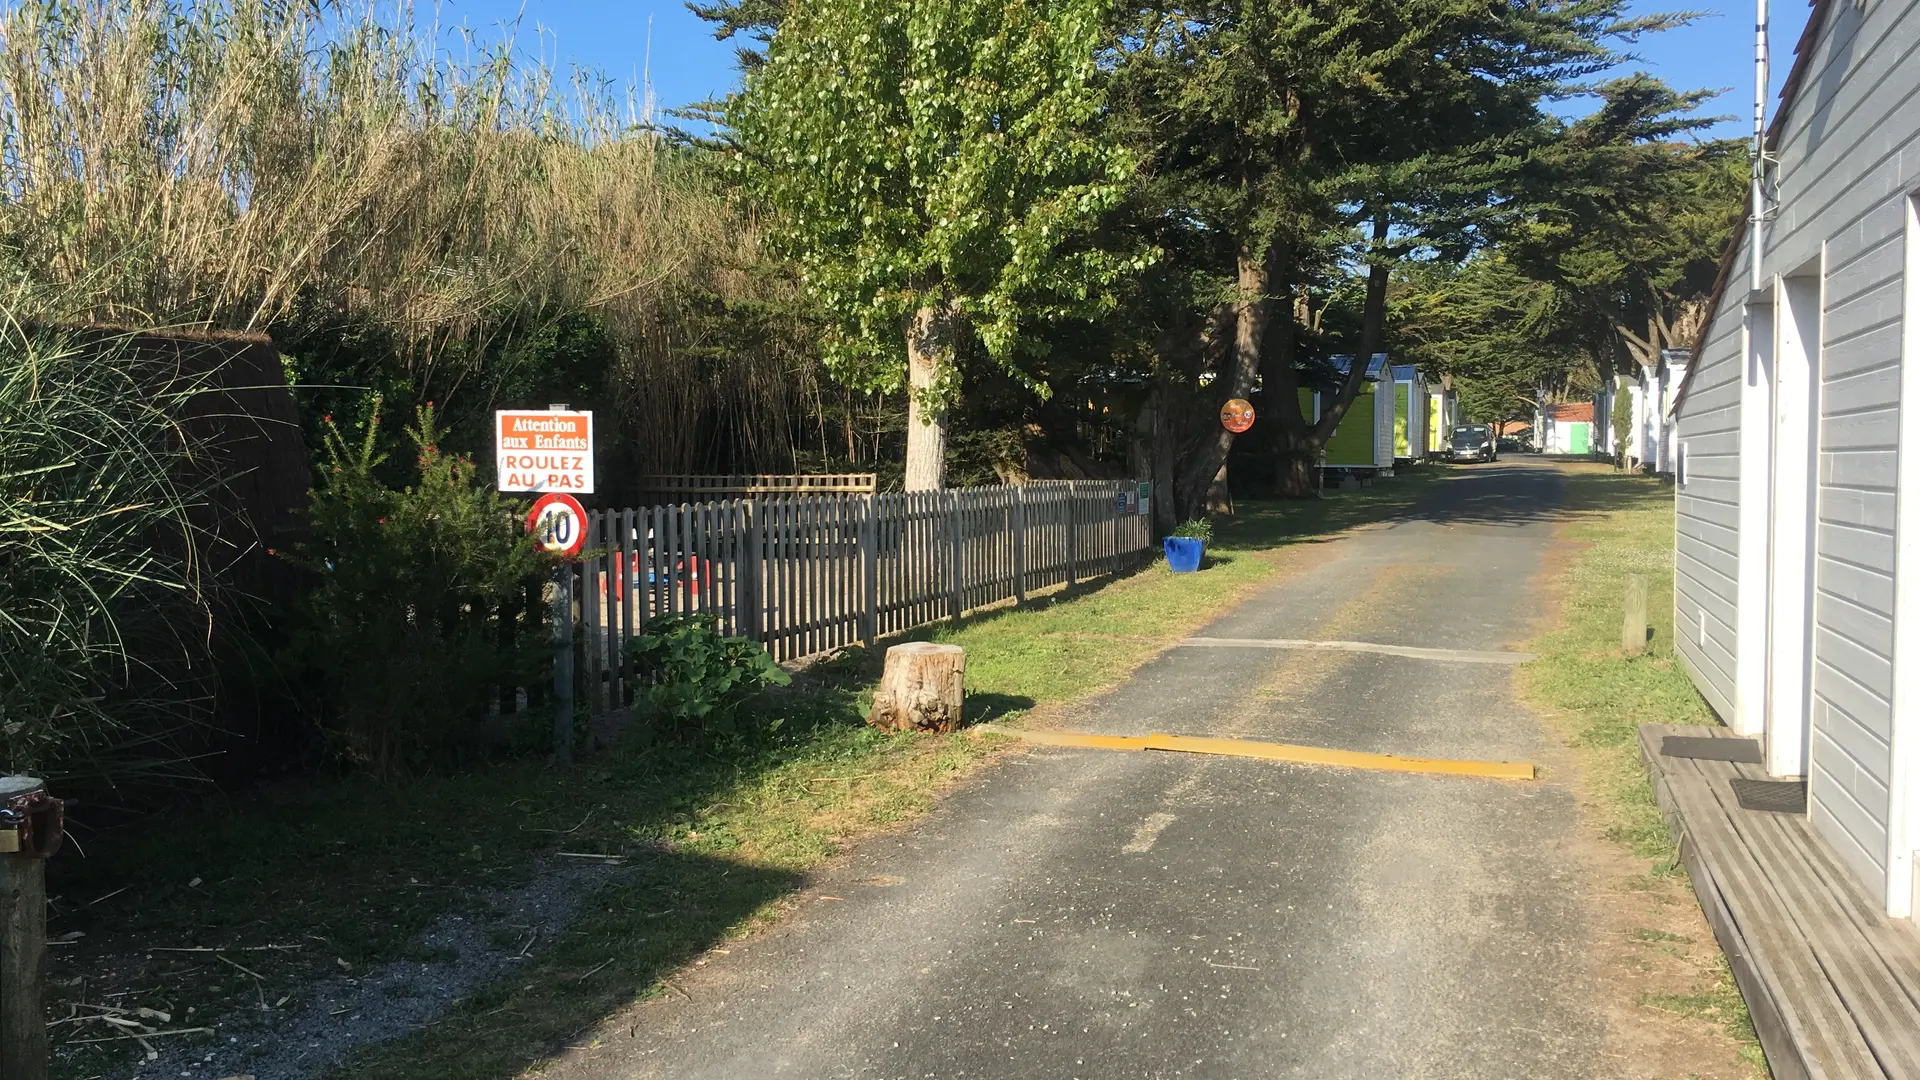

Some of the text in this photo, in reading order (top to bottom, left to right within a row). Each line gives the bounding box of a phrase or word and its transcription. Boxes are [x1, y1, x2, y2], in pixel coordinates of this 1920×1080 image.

[512, 417, 576, 432] Attention
[503, 434, 588, 449] aux Enfants
[506, 456, 584, 470] ROULEZ
[508, 473, 584, 488] AU PAS
[543, 510, 571, 544] 10
